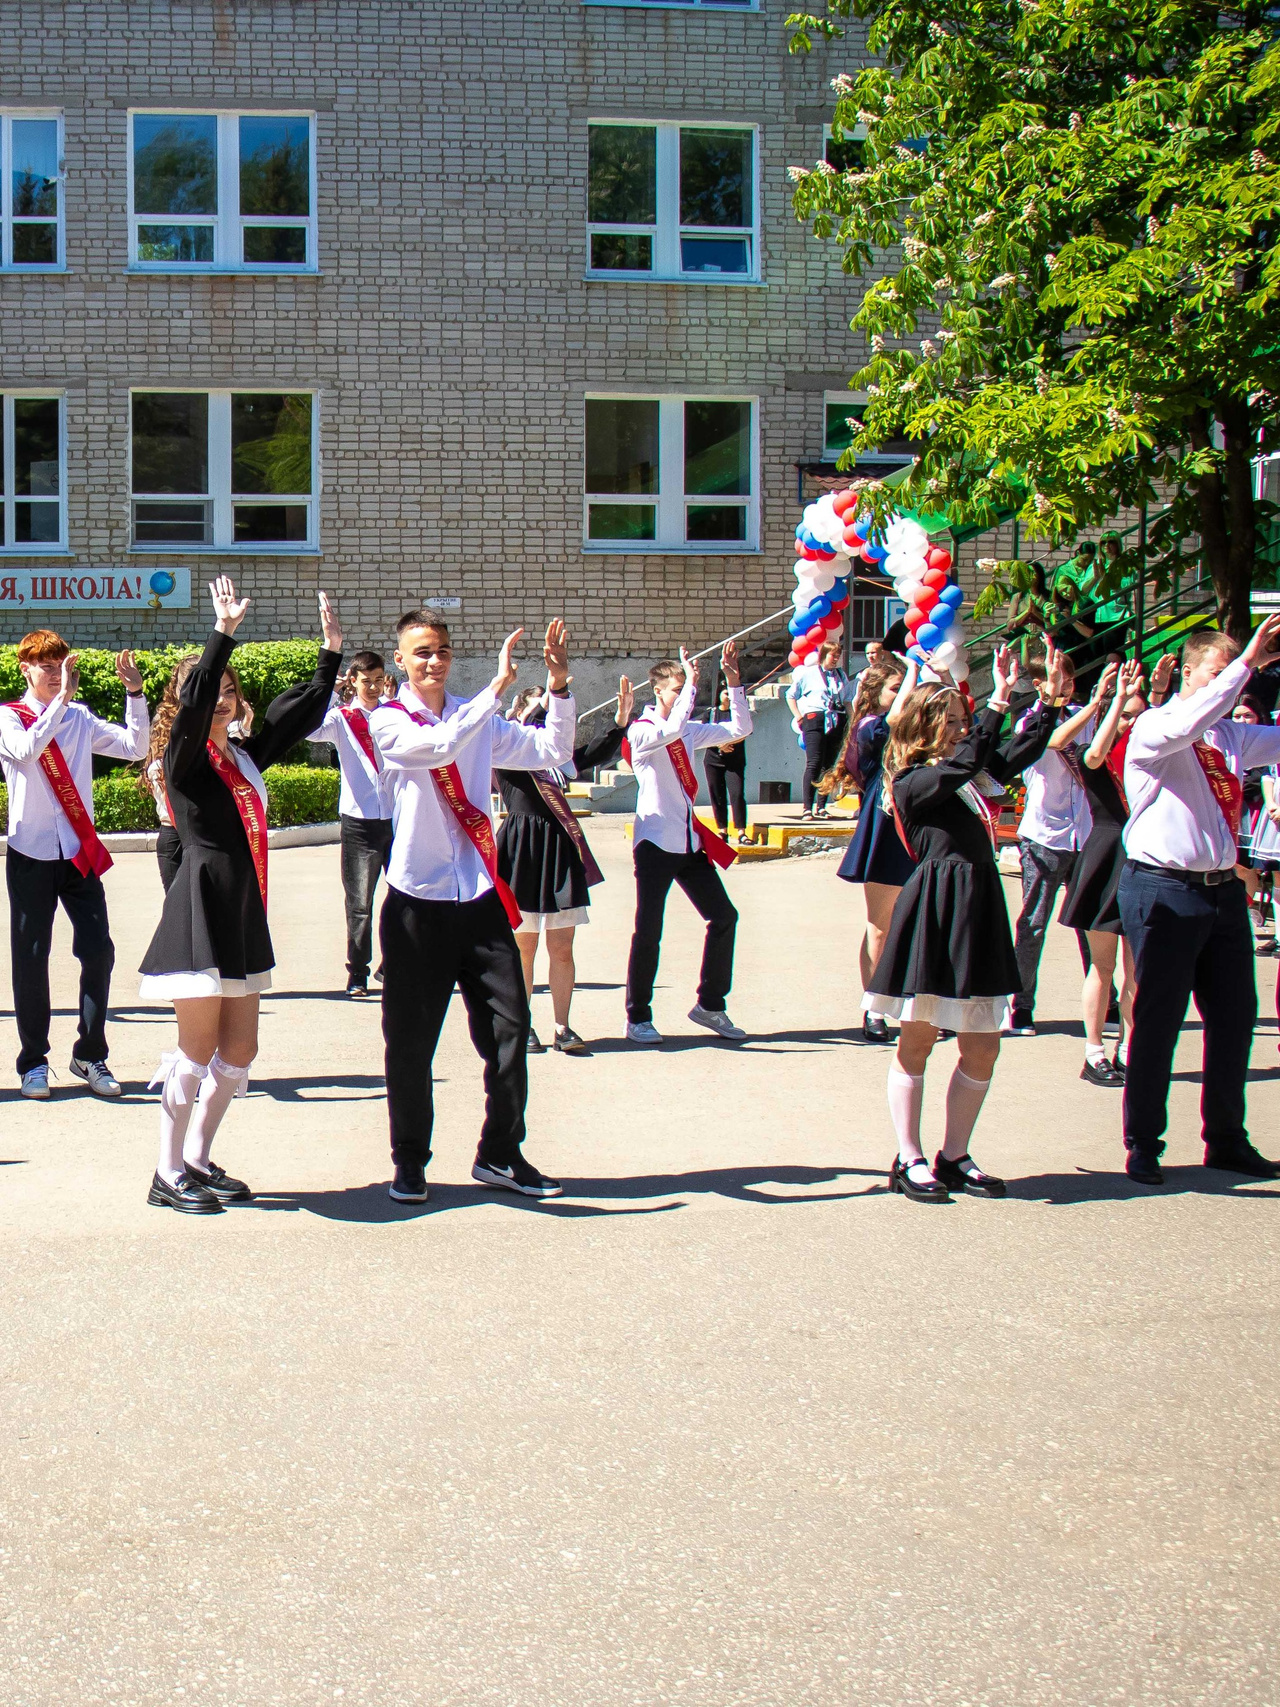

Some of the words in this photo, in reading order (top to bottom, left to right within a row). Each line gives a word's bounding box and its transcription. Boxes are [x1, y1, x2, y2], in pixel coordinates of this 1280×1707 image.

[30, 576, 142, 600] ШКОЛА!
[57, 779, 79, 807] 2025
[436, 767, 465, 813] пускник
[465, 812, 490, 843] 2025
